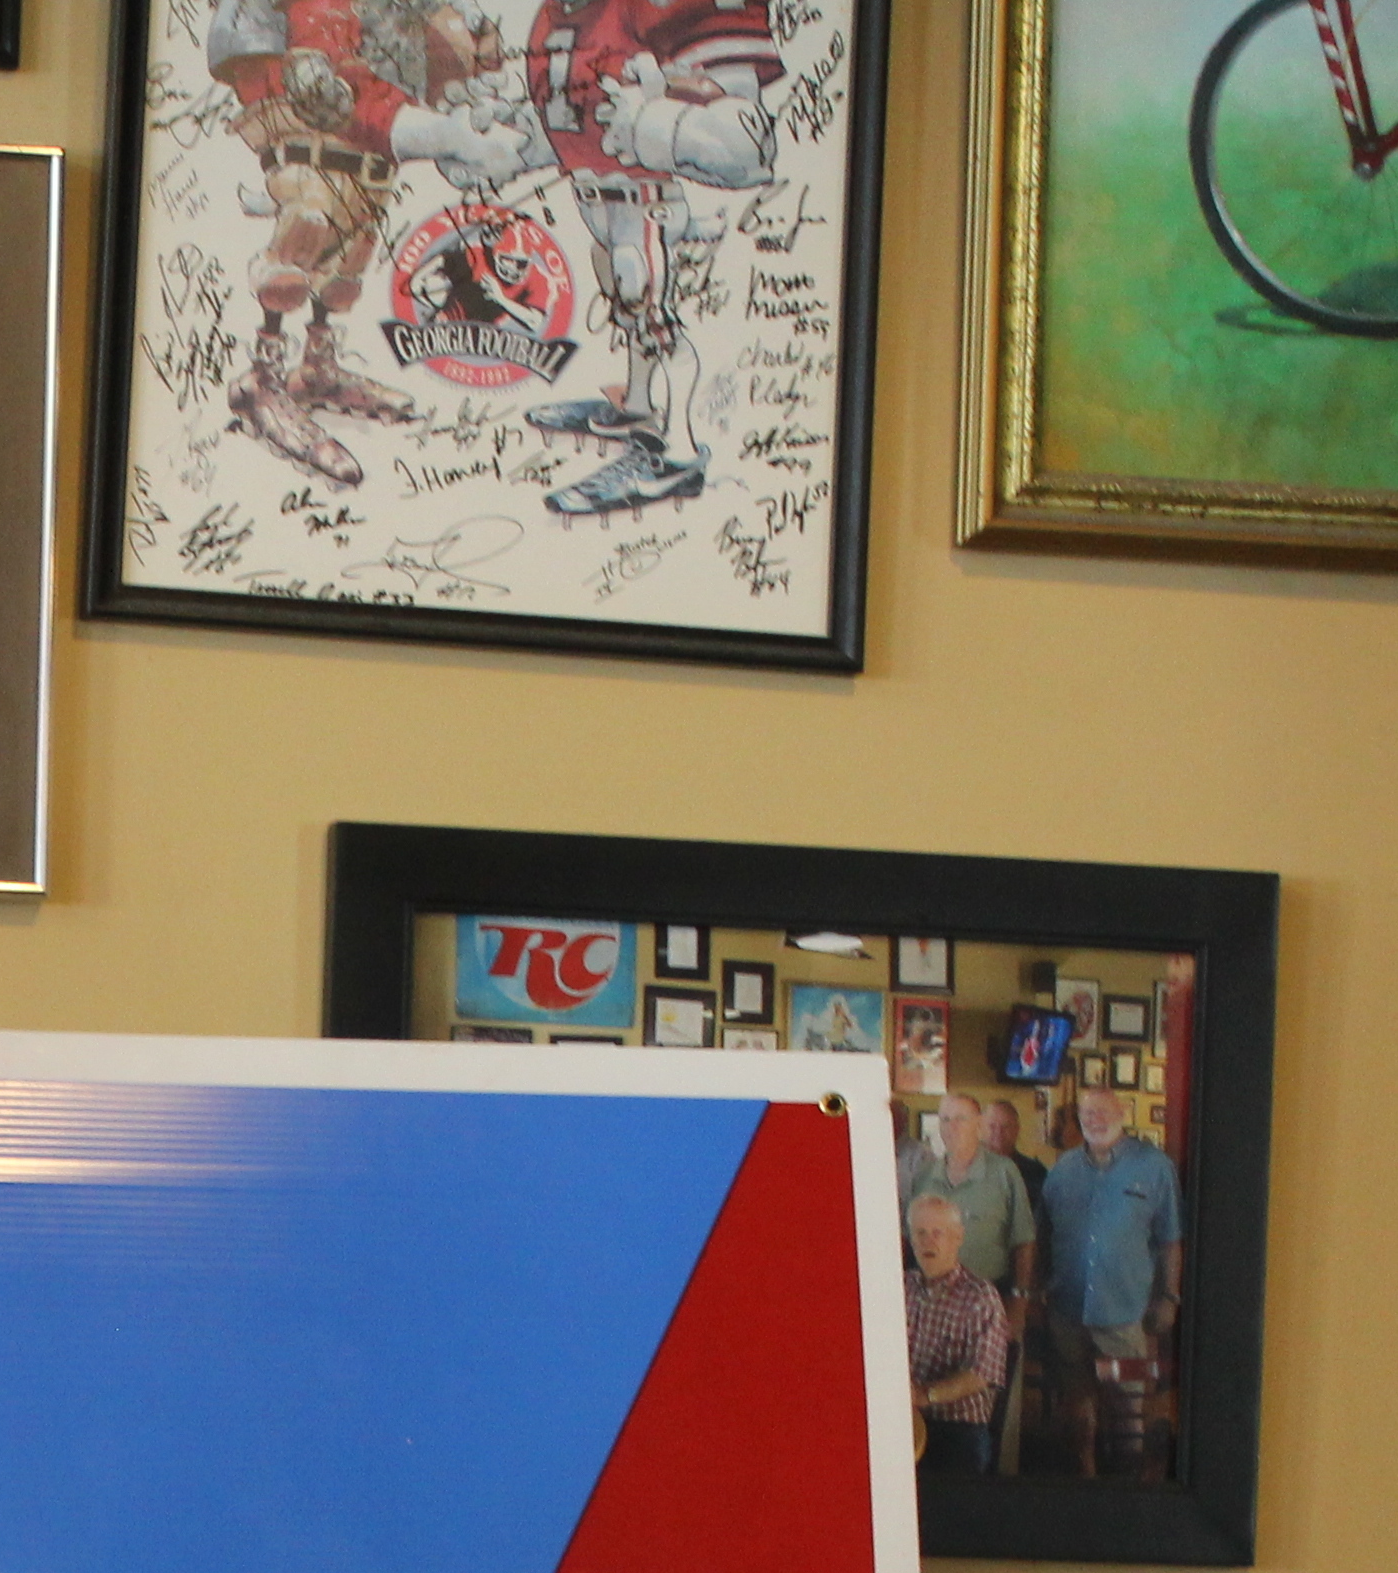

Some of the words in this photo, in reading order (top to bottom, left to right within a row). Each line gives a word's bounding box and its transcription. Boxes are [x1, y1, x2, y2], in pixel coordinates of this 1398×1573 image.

[393, 324, 476, 363] GEORGIA
[478, 327, 567, 380] FOOTBALL
[479, 924, 617, 1010] RC
